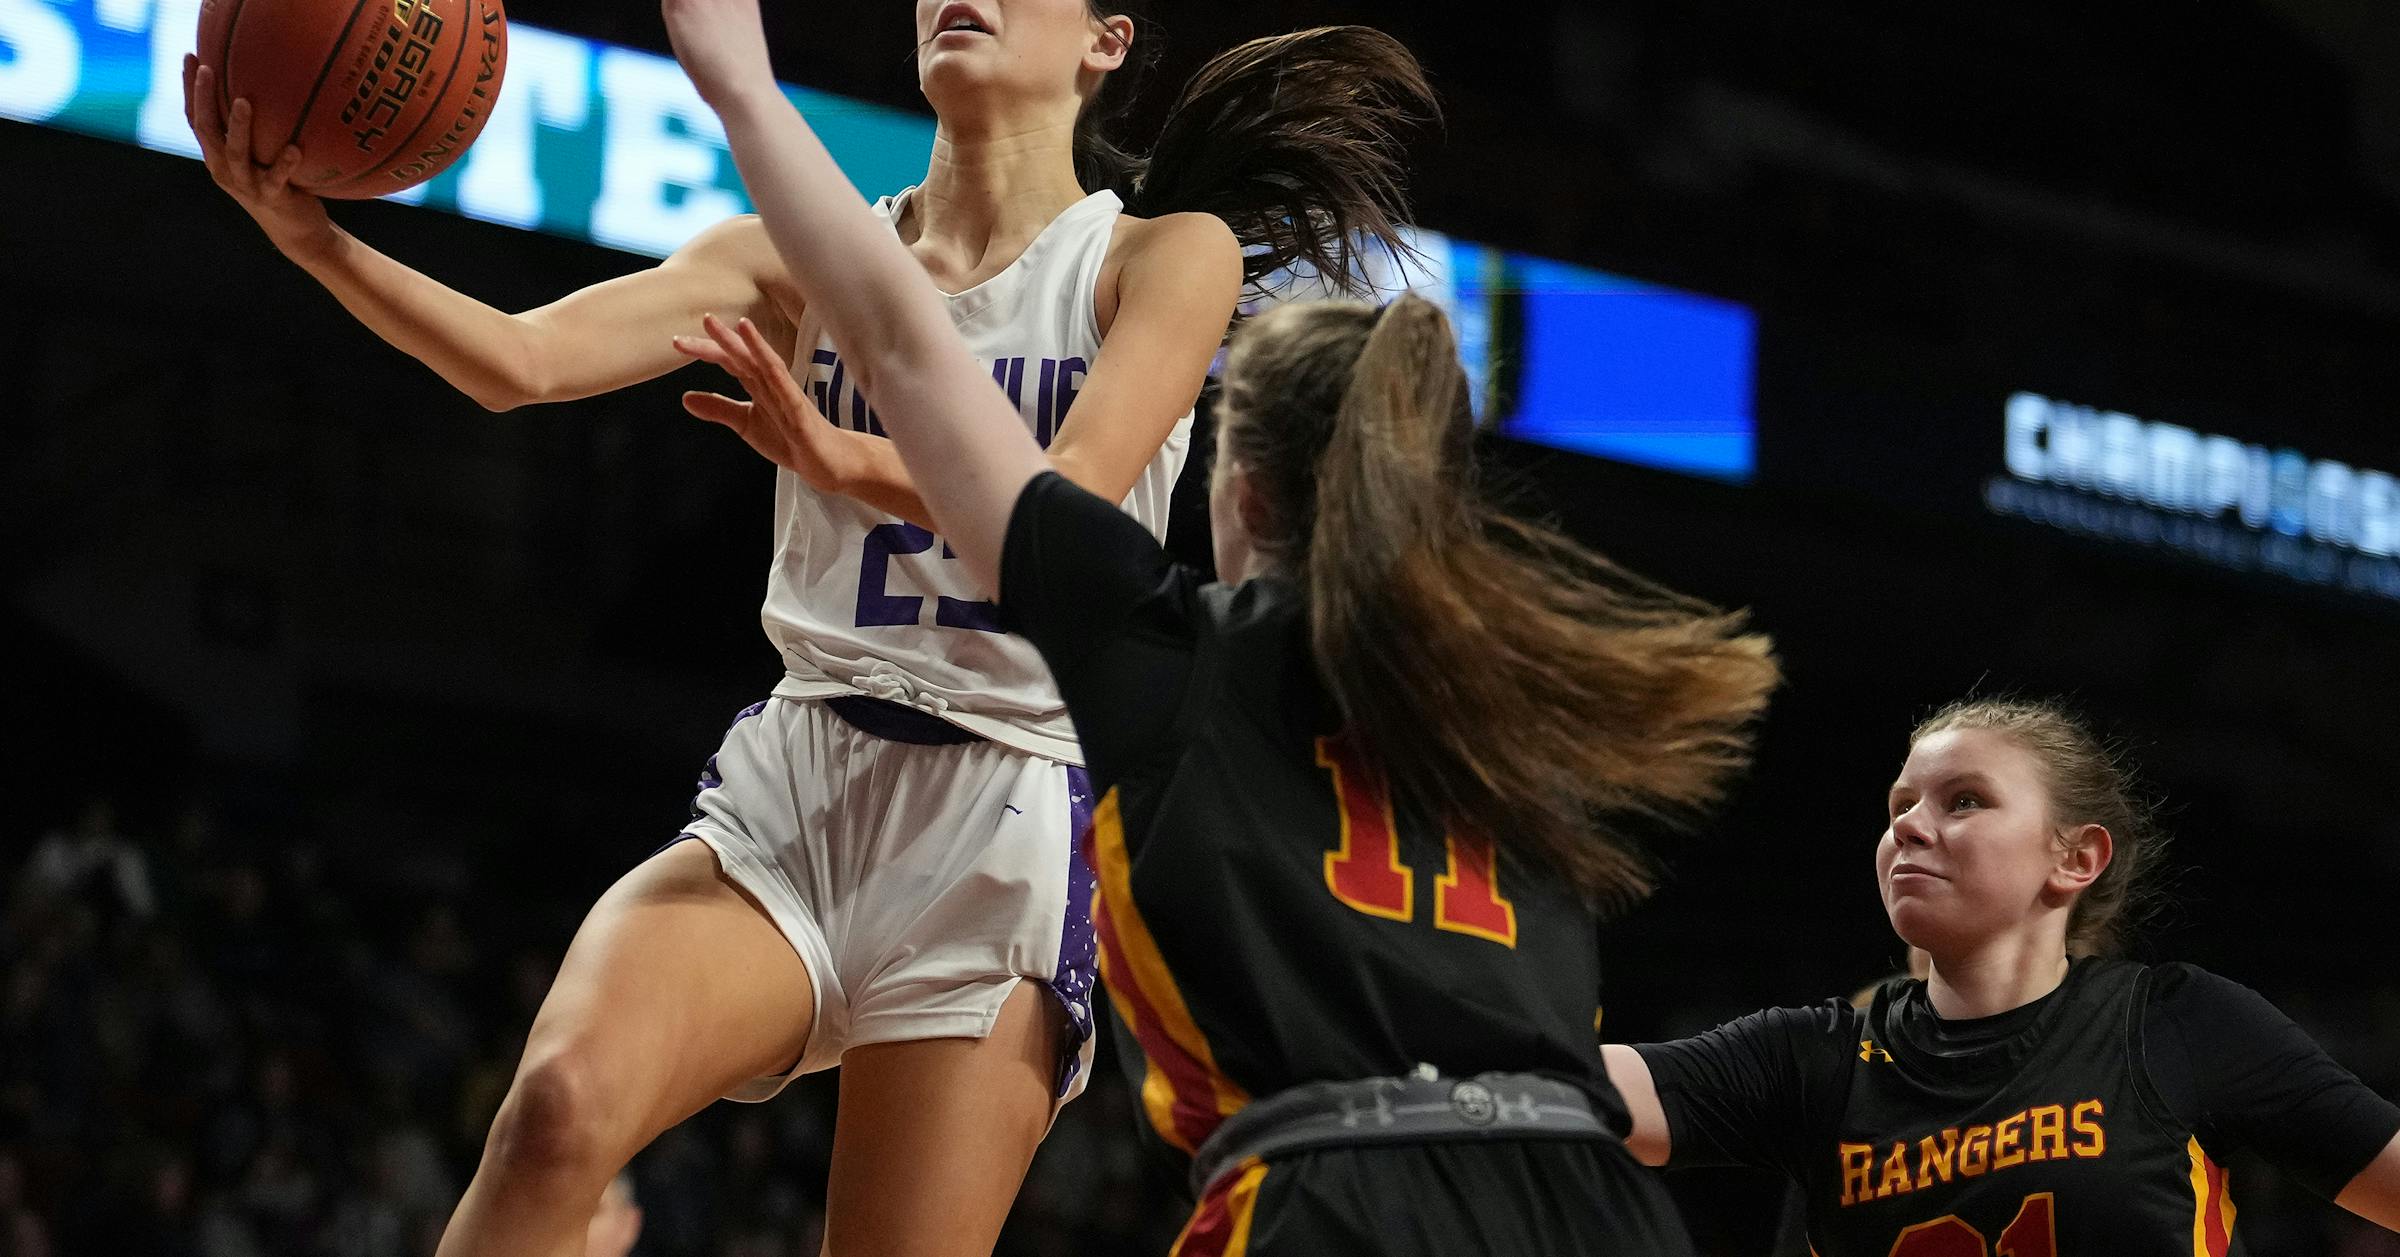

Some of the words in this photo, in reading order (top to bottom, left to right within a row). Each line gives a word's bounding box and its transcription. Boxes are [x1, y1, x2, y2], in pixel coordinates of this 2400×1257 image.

[0, 0, 750, 259] STTE
[352, 0, 443, 153] EGACY
[389, 0, 500, 182] SPALDING
[1316, 736, 1516, 949] 11
[1838, 1098, 2106, 1208] RANGERS
